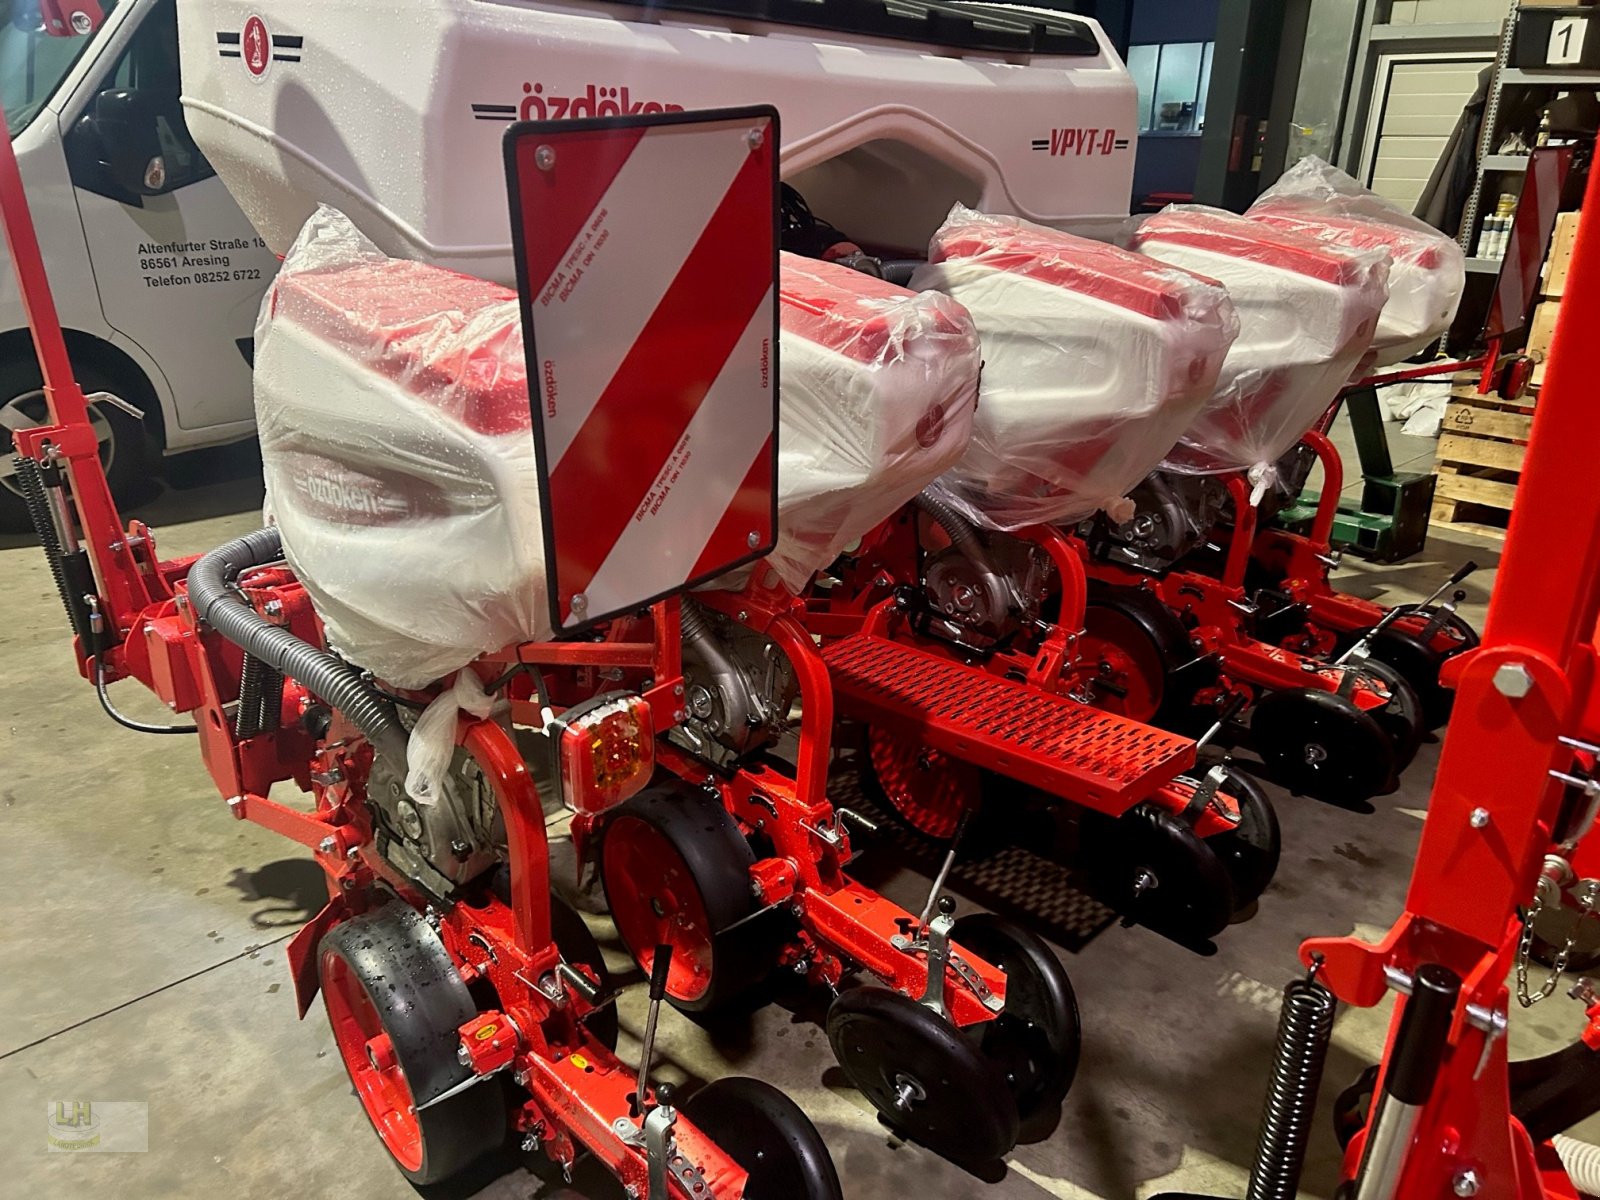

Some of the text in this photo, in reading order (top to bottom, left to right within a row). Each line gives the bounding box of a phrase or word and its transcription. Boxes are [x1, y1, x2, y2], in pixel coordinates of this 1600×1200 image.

[1558, 23, 1573, 58] 1
[520, 82, 685, 122] özdök
[1050, 128, 1115, 156] VPYT-D
[138, 242, 206, 255] Altenfurter
[210, 239, 249, 251] Straße
[140, 254, 231, 270] 86561 Aresing
[143, 269, 261, 287] Telefon 08252 6722
[544, 360, 558, 418] özdöken
